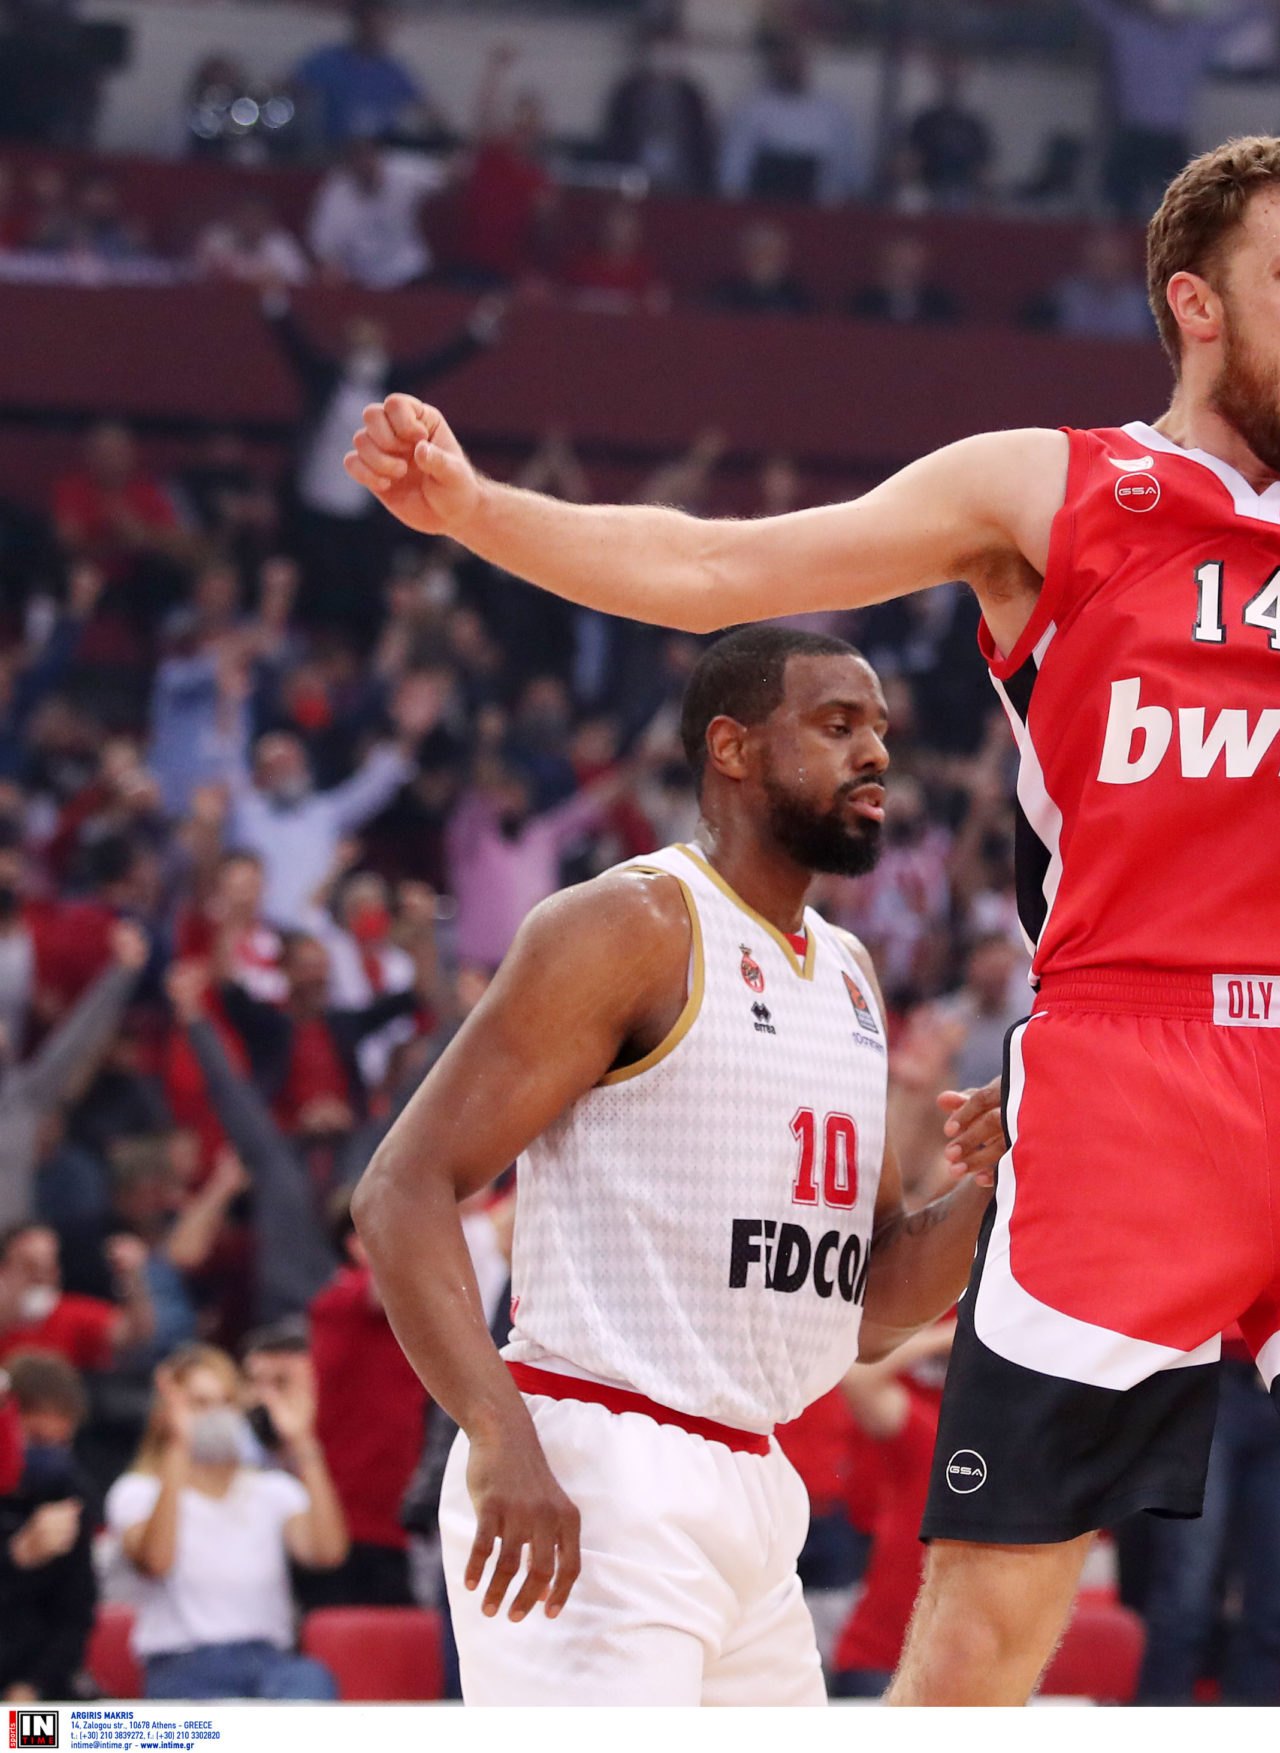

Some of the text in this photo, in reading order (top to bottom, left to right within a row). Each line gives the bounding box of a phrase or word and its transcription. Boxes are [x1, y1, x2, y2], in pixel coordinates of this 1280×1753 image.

[1119, 486, 1157, 496] GSA
[1228, 981, 1273, 1019] OLY
[789, 1106, 859, 1210] 10
[950, 1465, 983, 1477] GSA
